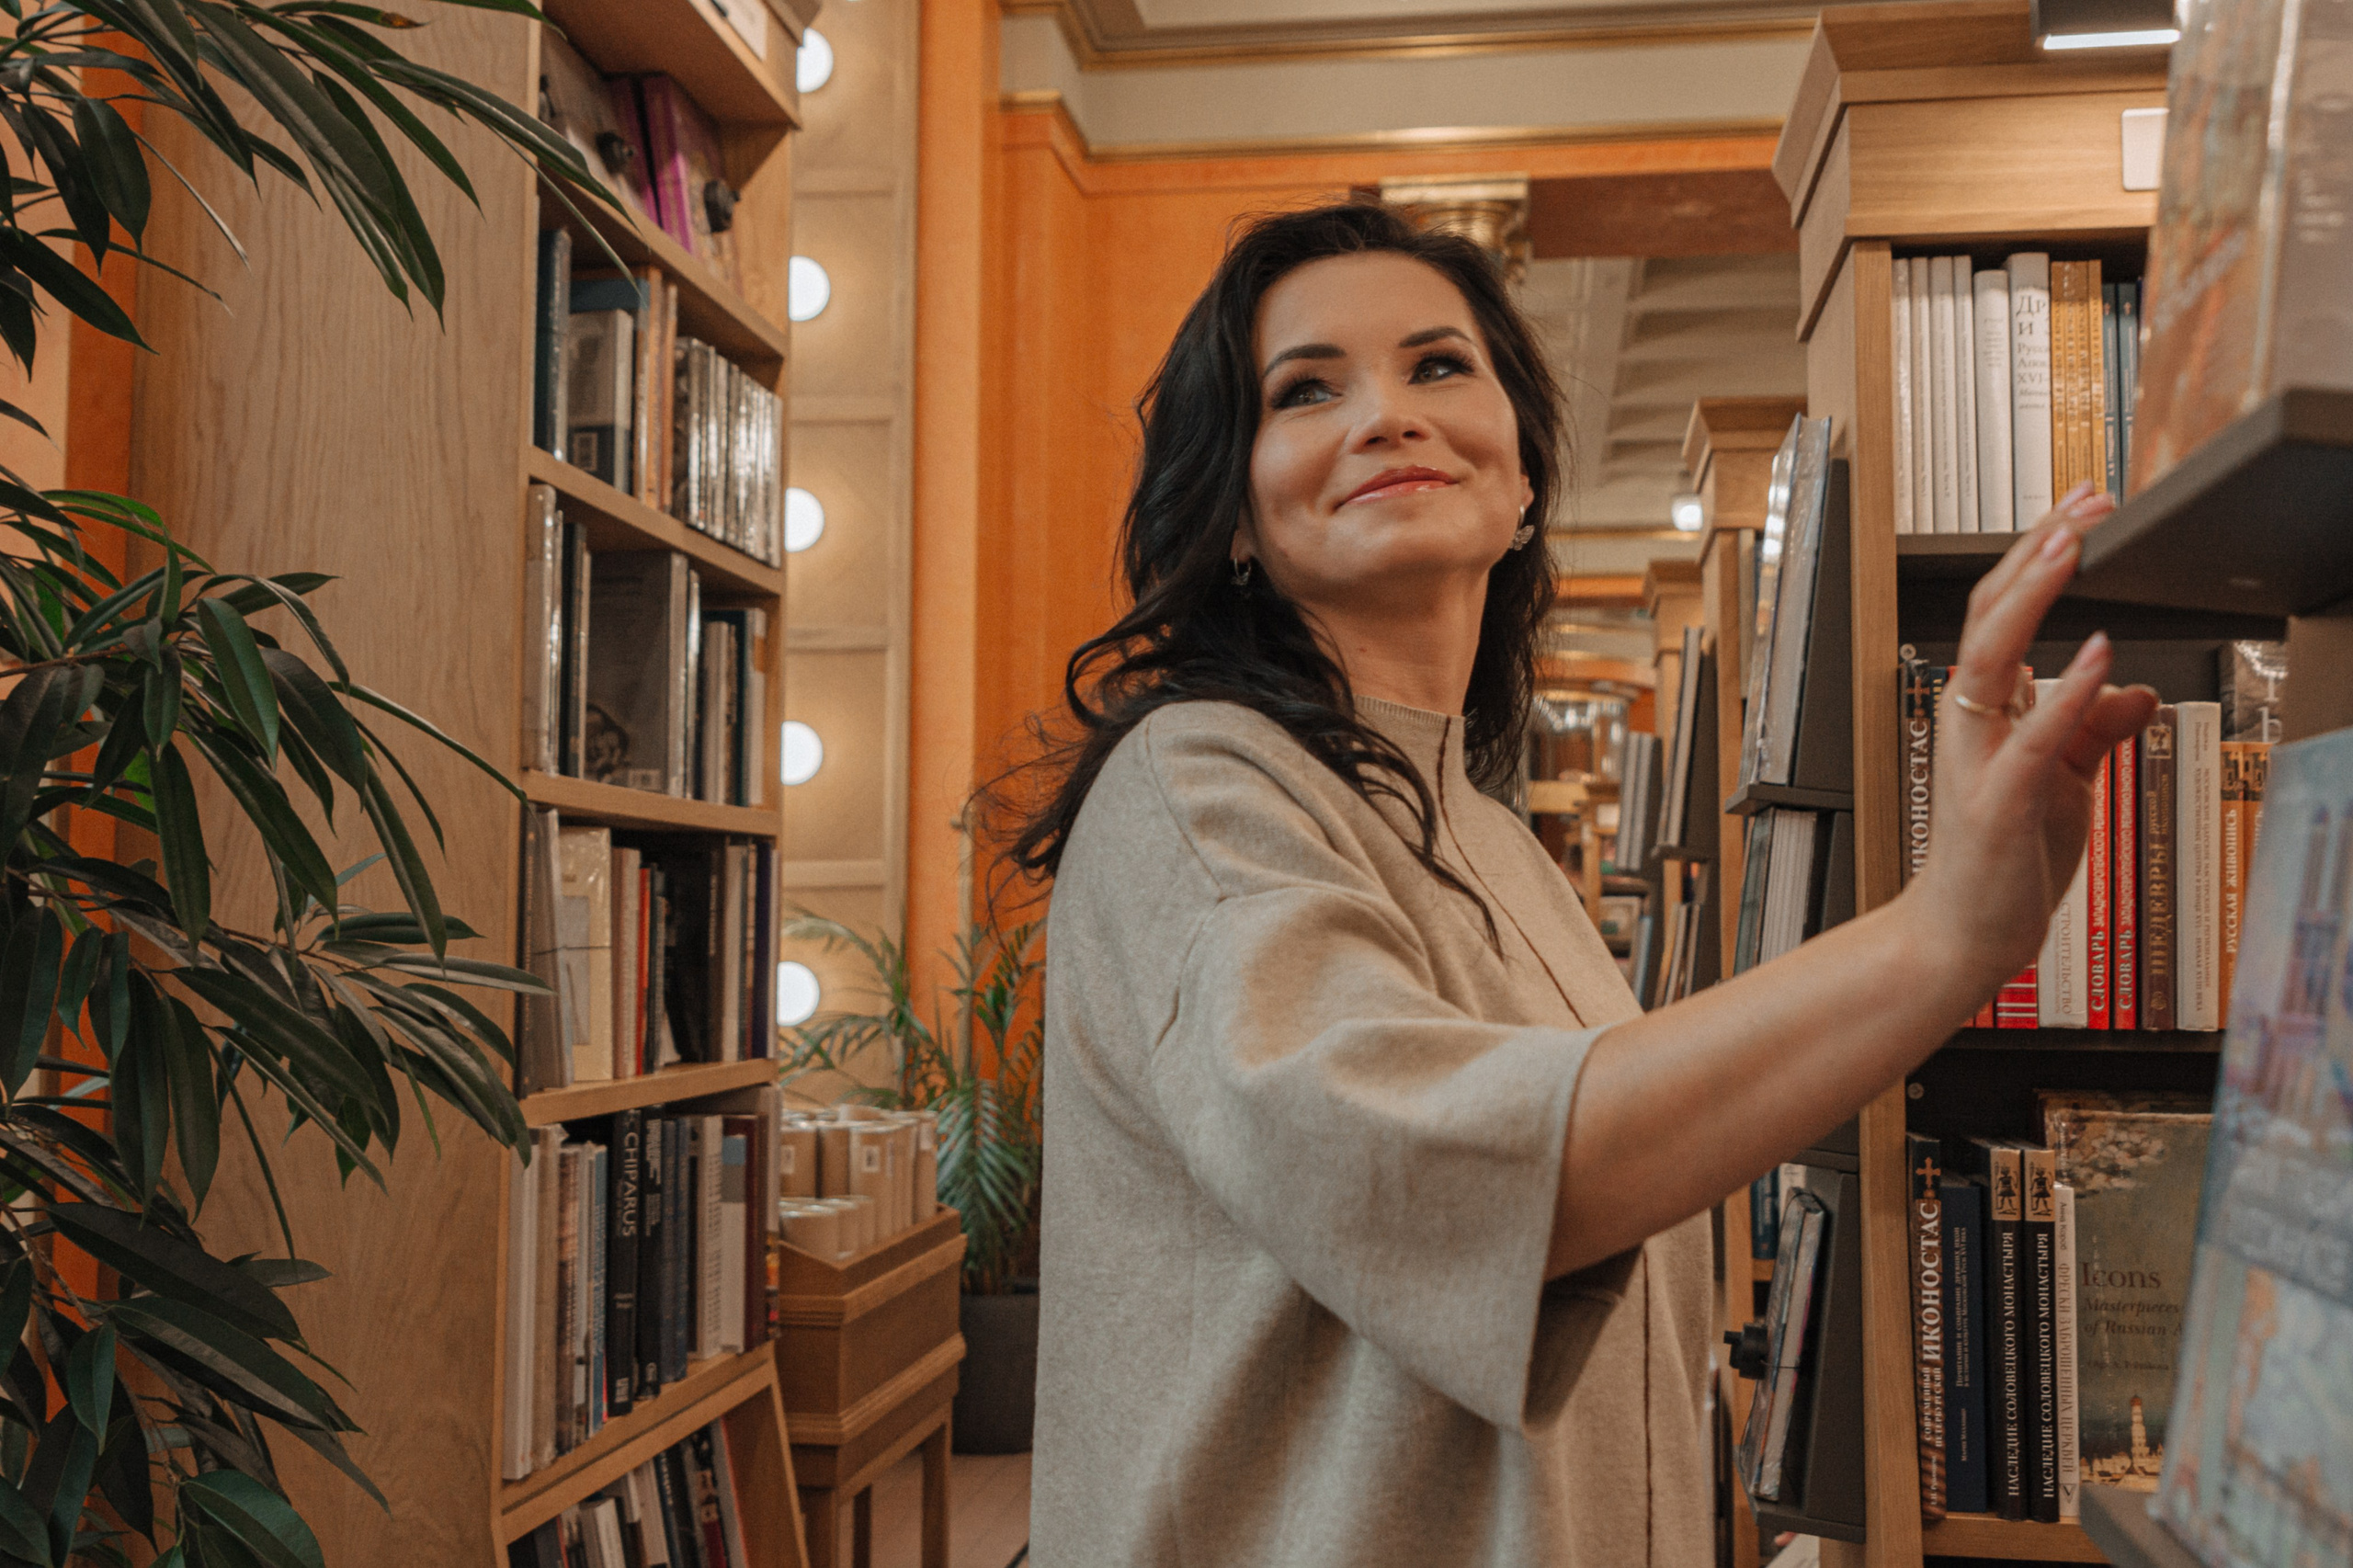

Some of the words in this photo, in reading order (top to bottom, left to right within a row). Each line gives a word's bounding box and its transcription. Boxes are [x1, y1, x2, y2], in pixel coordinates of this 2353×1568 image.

[1909, 721, 1929, 873] ИКОНОСТАС
[2121, 767, 2132, 829] РЕЛИГИОЗНОГО
[2092, 831, 2106, 927] ЗАПАДНОЕВРОПЕЙСКОГО
[2120, 830, 2134, 926] ЗАПАДНОЕВРОПЕЙСКОГО
[2224, 809, 2237, 889] ЖИВОПИСЬ
[2148, 843, 2173, 975] ШЕДЕВРЫ
[2225, 893, 2238, 953] РУССКАЯ
[2061, 902, 2073, 1015] СТРОИТЕЛЬСТВО
[2091, 931, 2106, 1012] СЛОВАРЬ
[2119, 930, 2133, 1011] СЛОВАРЬ
[621, 1131, 639, 1237] CHIPARUS
[1919, 1202, 1941, 1361] ИКОНОСТАС
[2002, 1232, 2015, 1317] МОНАСТЫРЯ
[2037, 1233, 2050, 1318] МОНАСТЫРЯ
[2058, 1263, 2071, 1312] ФРЕСКИ
[2080, 1262, 2162, 1289] Icons
[2084, 1298, 2180, 1317] Masterpieces
[2059, 1318, 2073, 1413] ЗАБРОШЕННЫХ
[2084, 1320, 2101, 1337] of
[2105, 1320, 2166, 1335] Russian
[1922, 1368, 1932, 1441] СОВРЕМЕННЫЙ
[1933, 1368, 1943, 1448] ПЕТЕРБУРГСКИЙ
[2004, 1320, 2018, 1420] СОЛОВЕЦКОГО
[2039, 1322, 2053, 1422] СОЛОВЕЦКОГО
[2006, 1423, 2020, 1497] НАСЛЕДИЕ
[2041, 1426, 2055, 1498] НАСЛЕДИЕ
